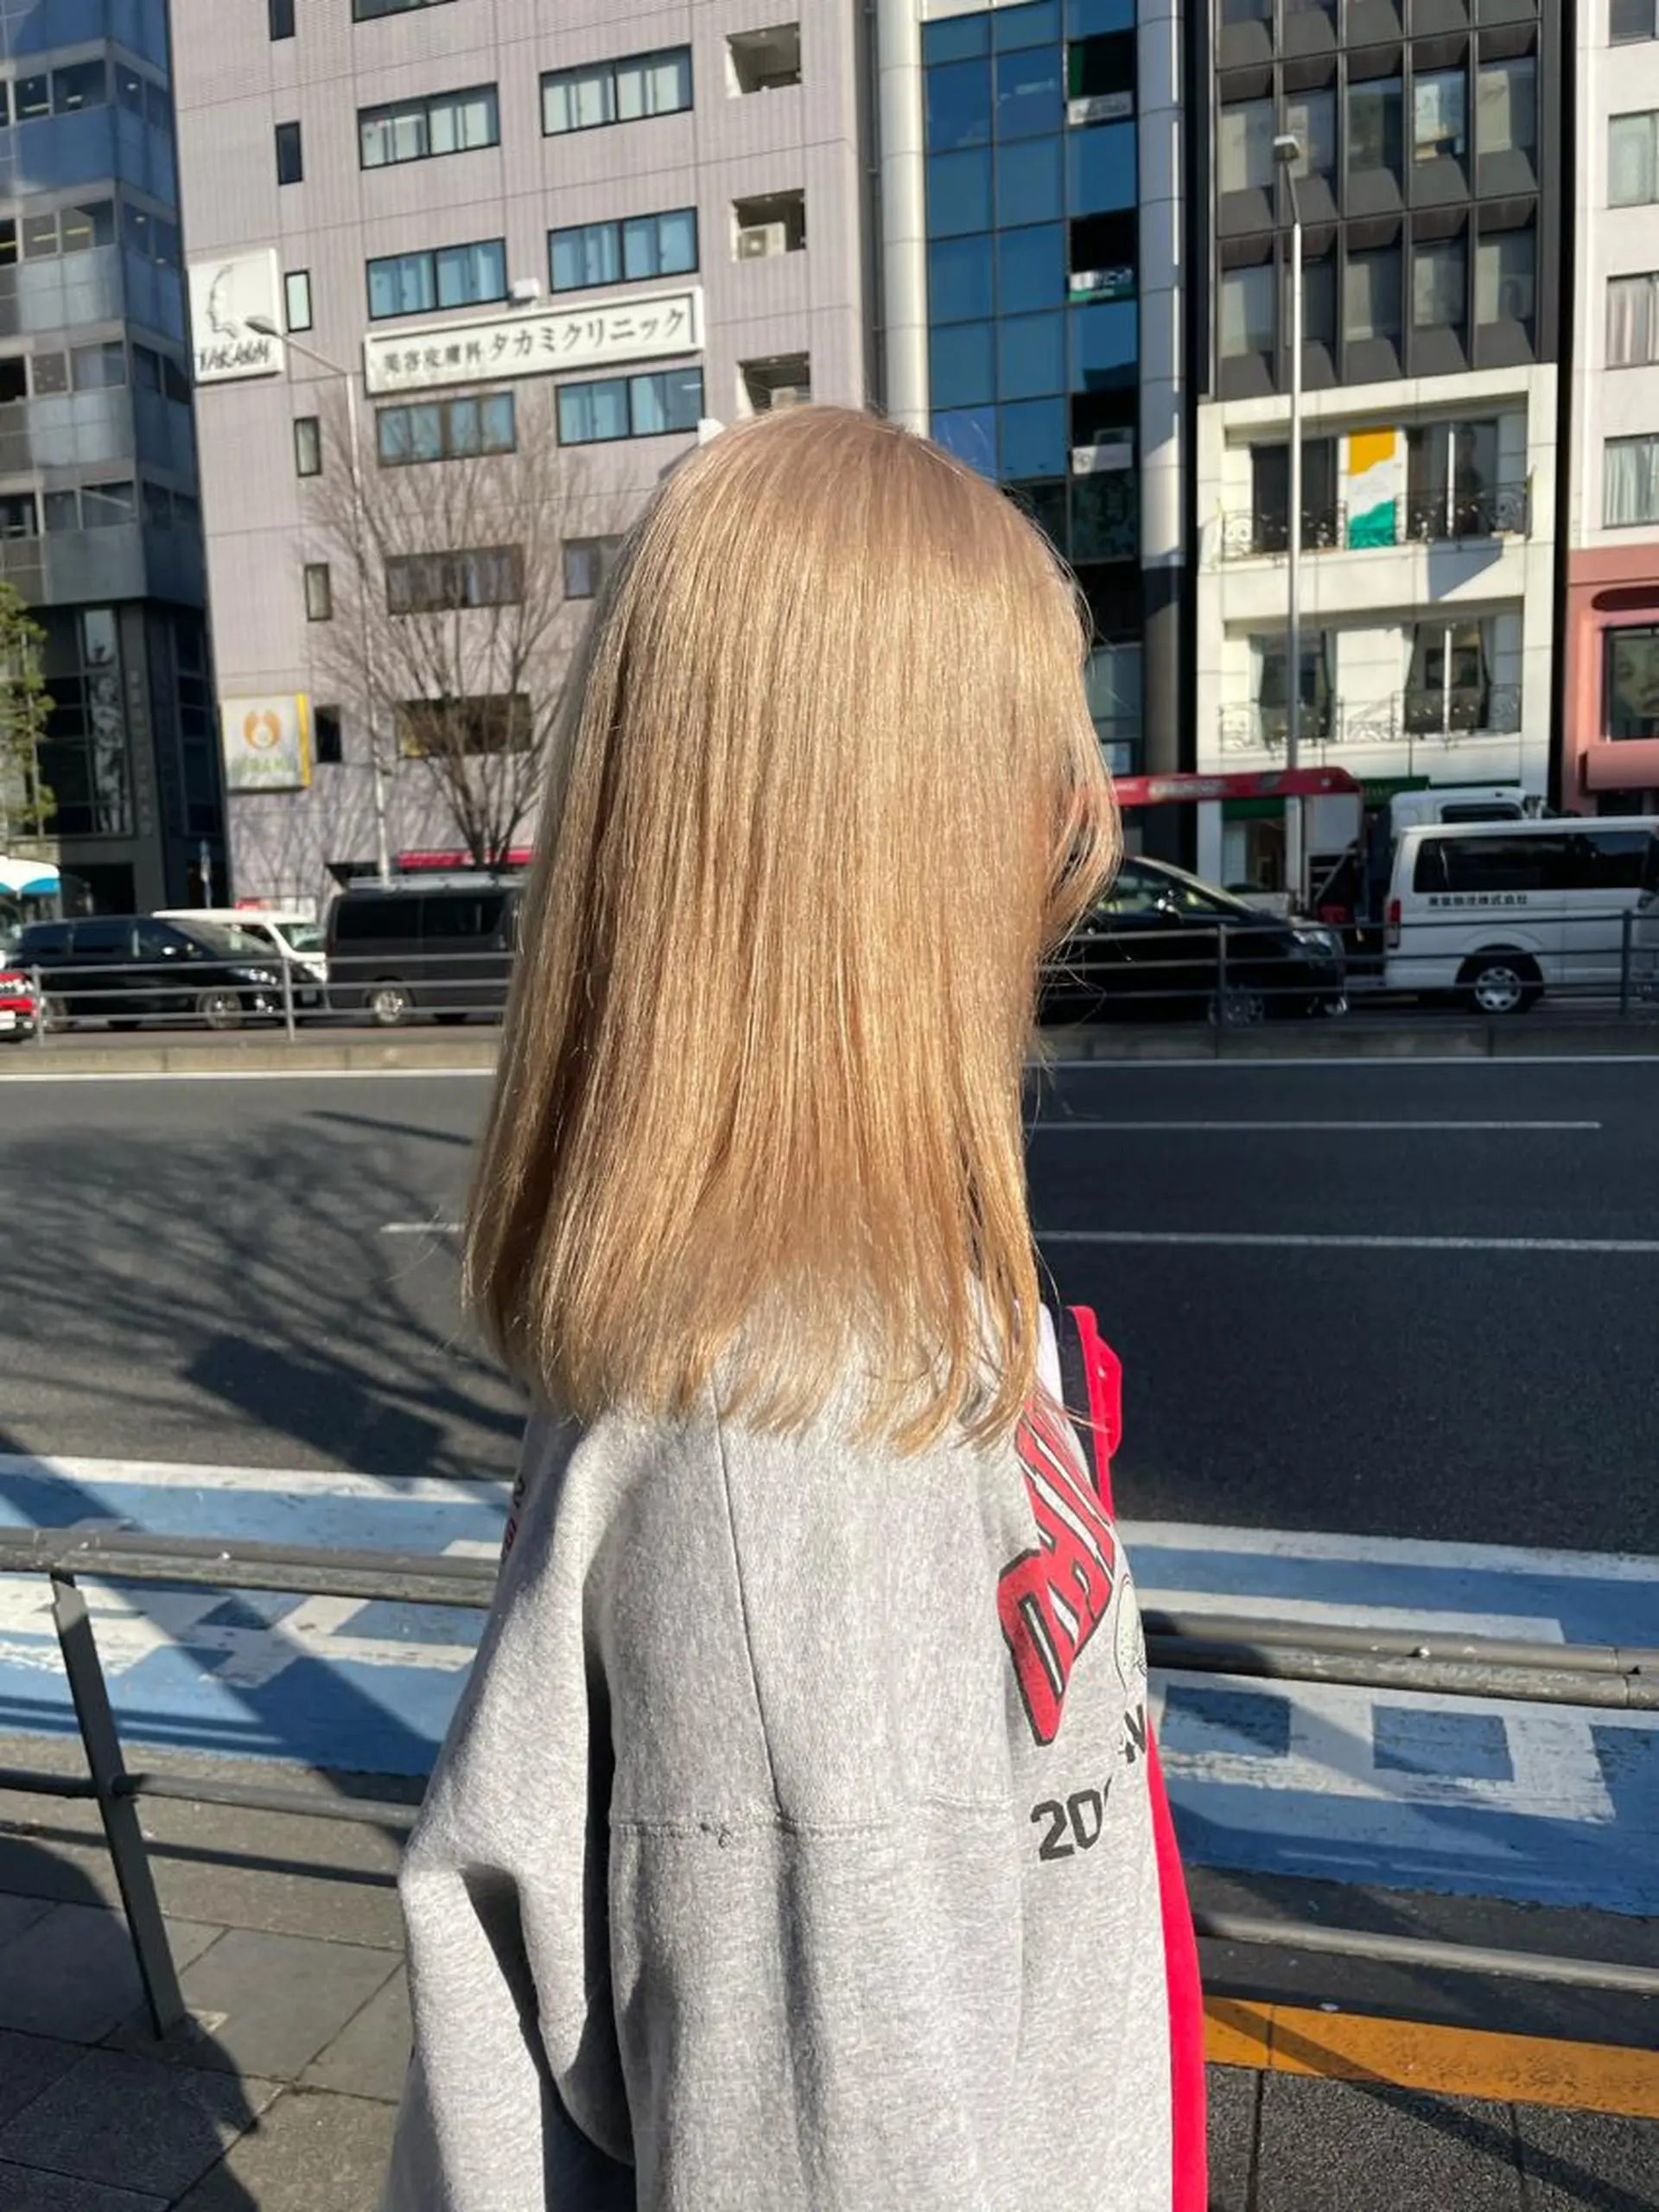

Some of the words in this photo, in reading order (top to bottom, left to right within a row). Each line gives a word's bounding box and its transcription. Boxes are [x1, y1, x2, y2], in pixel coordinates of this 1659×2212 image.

[488, 307, 685, 360] タカミクリニック
